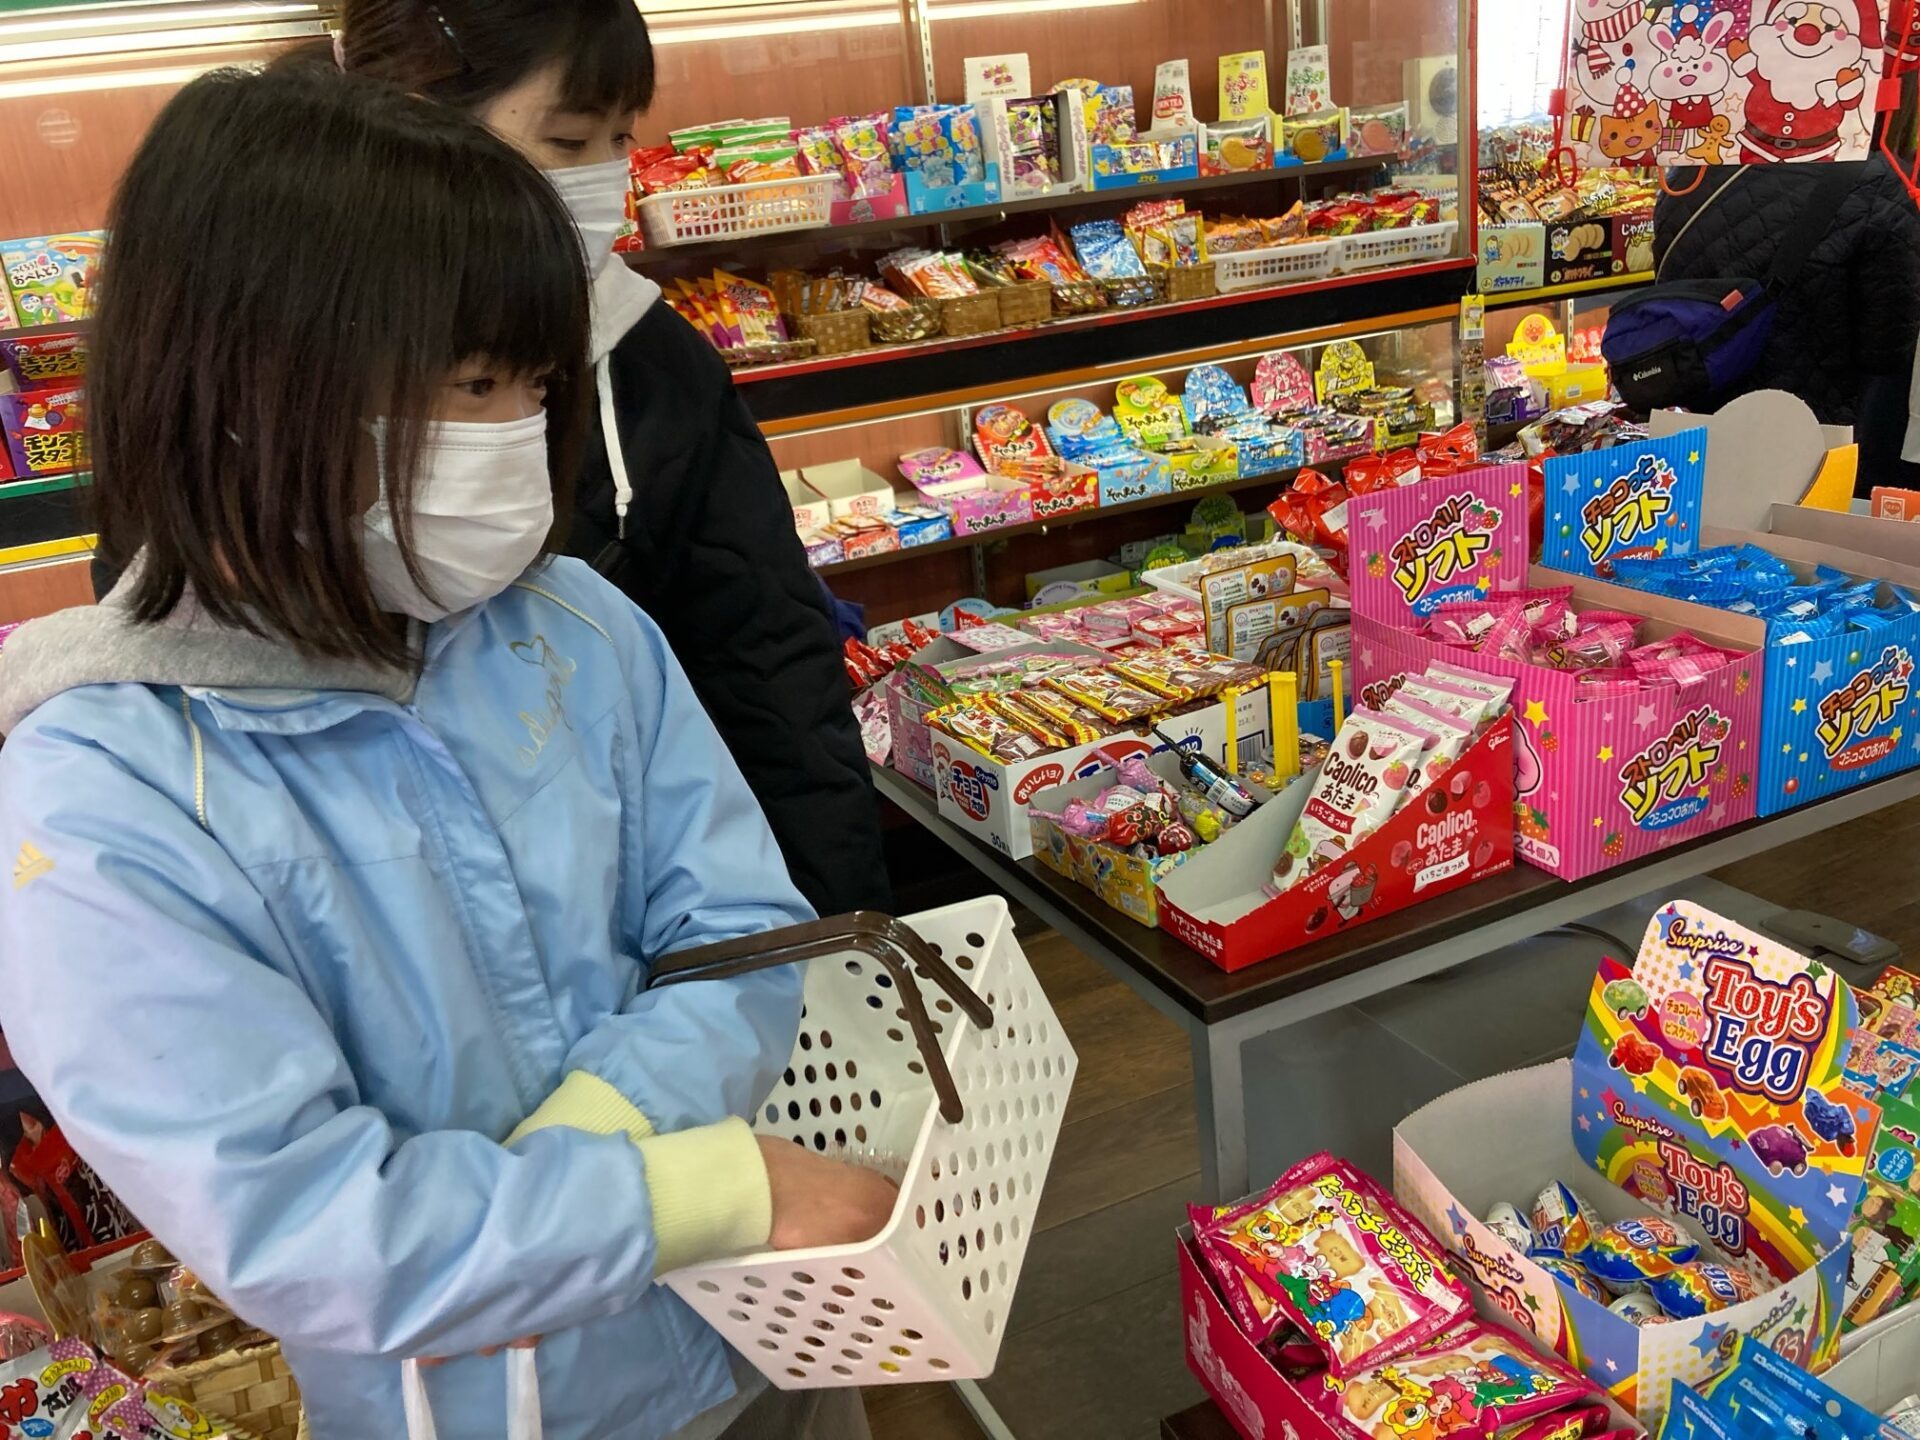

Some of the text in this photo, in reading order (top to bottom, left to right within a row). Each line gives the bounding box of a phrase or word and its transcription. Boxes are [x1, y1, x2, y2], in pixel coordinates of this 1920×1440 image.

[1583, 456, 1657, 527] チョコっと
[1391, 493, 1473, 567] ストロベリー
[1582, 490, 1671, 562] ソフト
[1393, 527, 1491, 603] ソフト
[1820, 647, 1899, 719] チョコっと
[1817, 680, 1908, 756] ソフト
[1621, 706, 1710, 787] ストロベリー
[952, 765, 983, 800] チョコ
[1320, 783, 1356, 810] あたま
[1322, 751, 1378, 795] Caplico
[1621, 742, 1720, 822] ソフト
[1310, 803, 1348, 829] いちごあつめ
[1416, 809, 1473, 850] Caplico
[1648, 800, 1701, 826] マシュマロおかし
[1420, 859, 1465, 881] いちごあつめ
[1425, 837, 1463, 866] あたま
[1513, 834, 1557, 864] 24個入
[1667, 919, 1743, 957] Surprise
[1666, 999, 1702, 1021] チョコレート
[1710, 961, 1822, 1039] Toy's
[1664, 1021, 1698, 1042] ビスケット
[1710, 1014, 1804, 1094] Egg
[1613, 1100, 1674, 1138] Surprise
[1660, 1141, 1746, 1210] Toy's
[1677, 1182, 1741, 1248] Egg
[1462, 1234, 1523, 1284] Surprise
